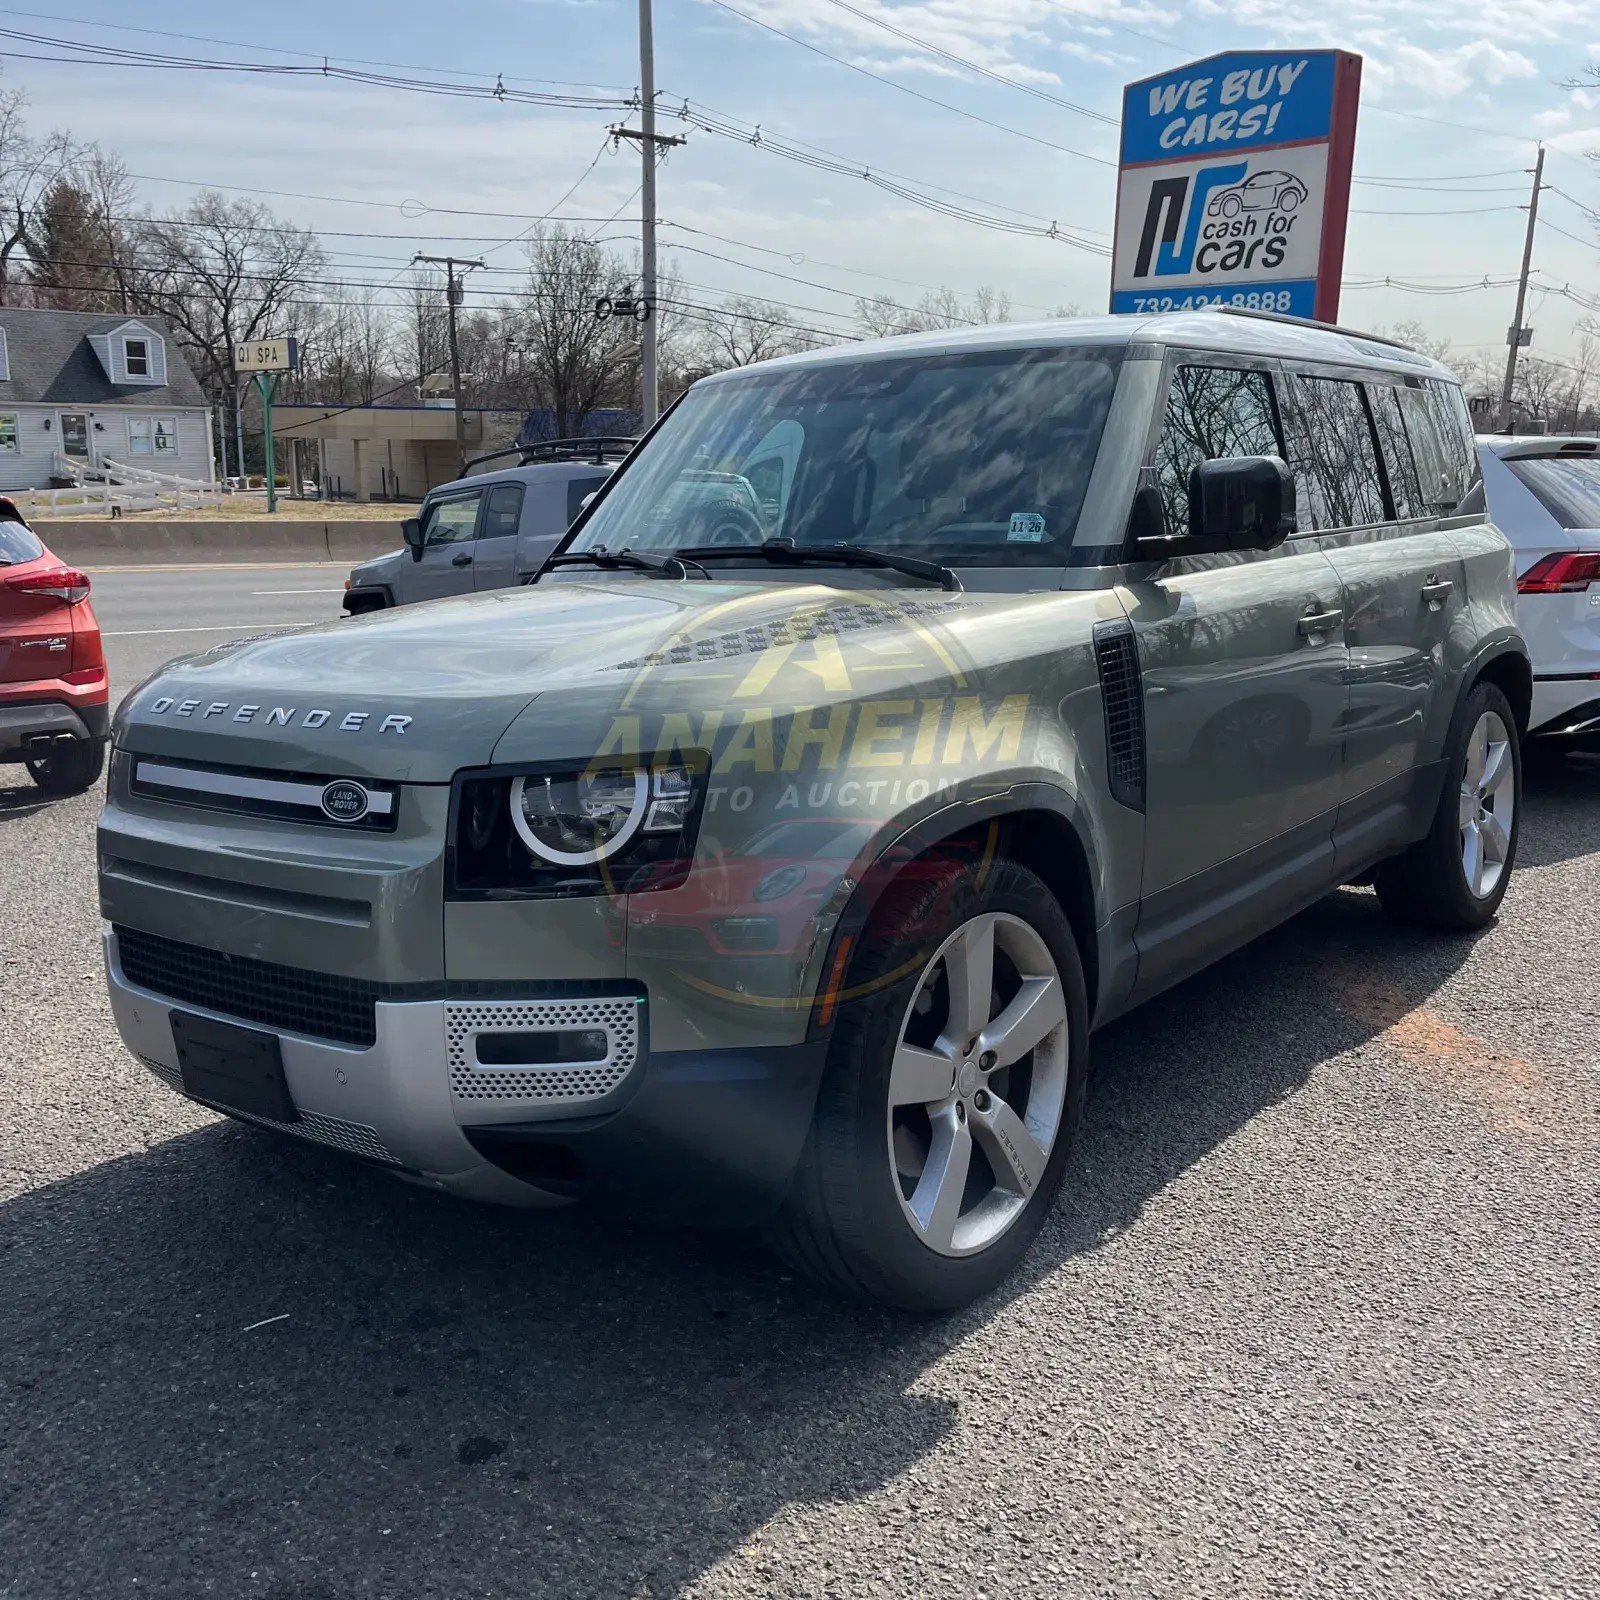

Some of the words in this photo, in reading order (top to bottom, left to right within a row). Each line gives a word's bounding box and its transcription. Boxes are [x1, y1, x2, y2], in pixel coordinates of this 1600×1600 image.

[1149, 77, 1213, 117] WE
[1219, 60, 1309, 106] BUY
[1159, 101, 1283, 149] CARS!
[1203, 215, 1257, 240] cash
[1264, 212, 1298, 234] for
[1195, 236, 1288, 273] cars
[257, 346, 279, 363] SPA
[1010, 521, 1025, 532] 11
[1028, 521, 1042, 533] 26
[150, 697, 413, 735] DEFENDER
